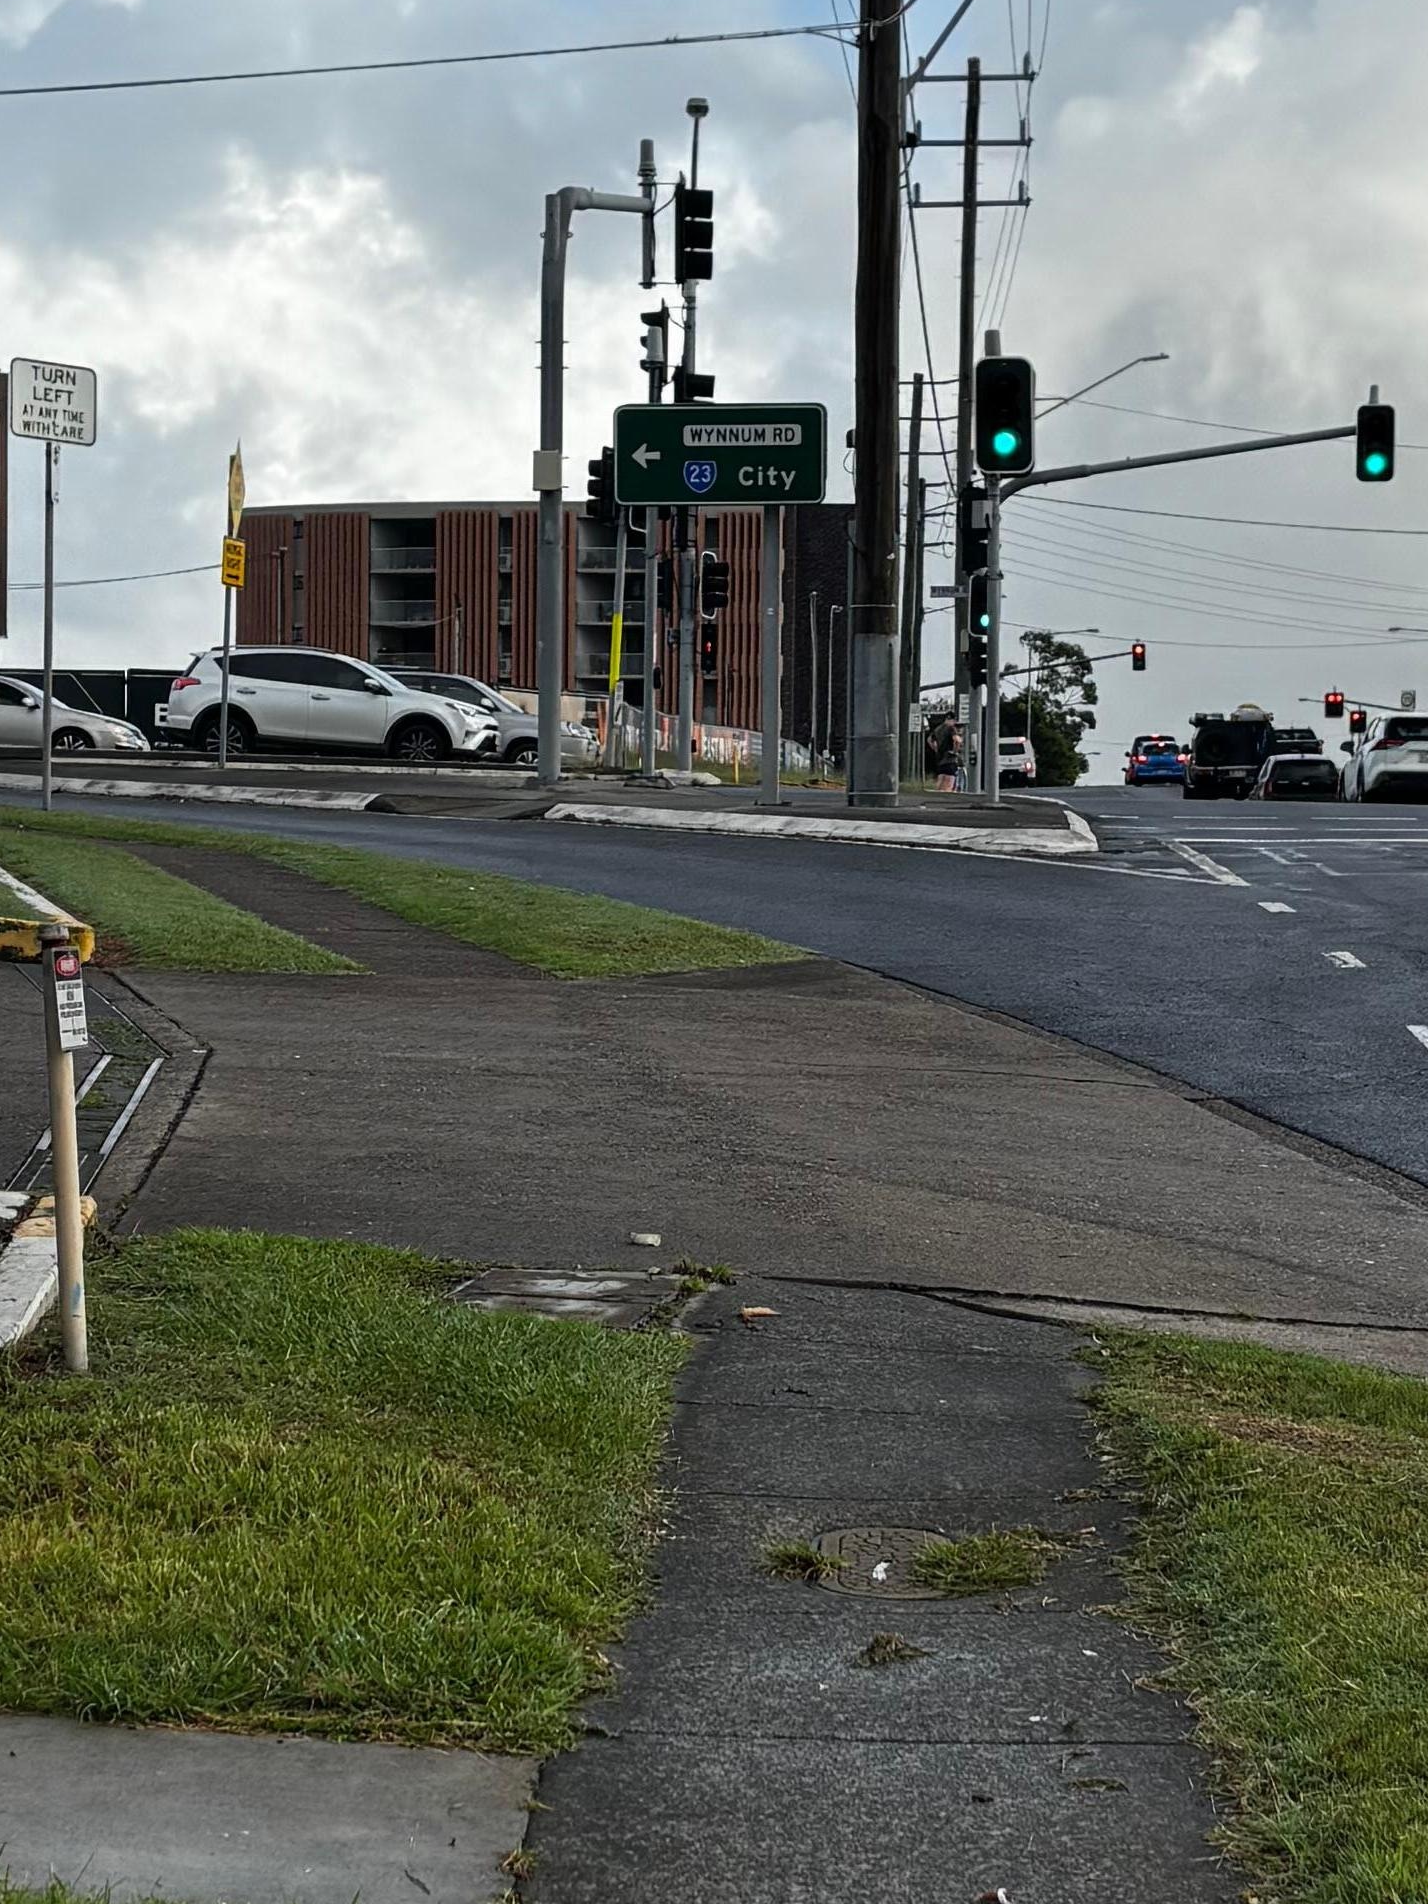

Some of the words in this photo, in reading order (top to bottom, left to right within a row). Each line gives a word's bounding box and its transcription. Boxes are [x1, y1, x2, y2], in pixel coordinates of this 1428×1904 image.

[32, 365, 76, 386] TURN
[33, 385, 73, 406] LEFT
[22, 404, 33, 416] AT
[39, 406, 58, 419] ANY
[63, 410, 84, 423] TIME
[22, 421, 50, 435] WITH
[690, 428, 766, 442] WYNNUM
[774, 428, 795, 442] RD
[690, 465, 711, 482] 23
[738, 466, 796, 490] City
